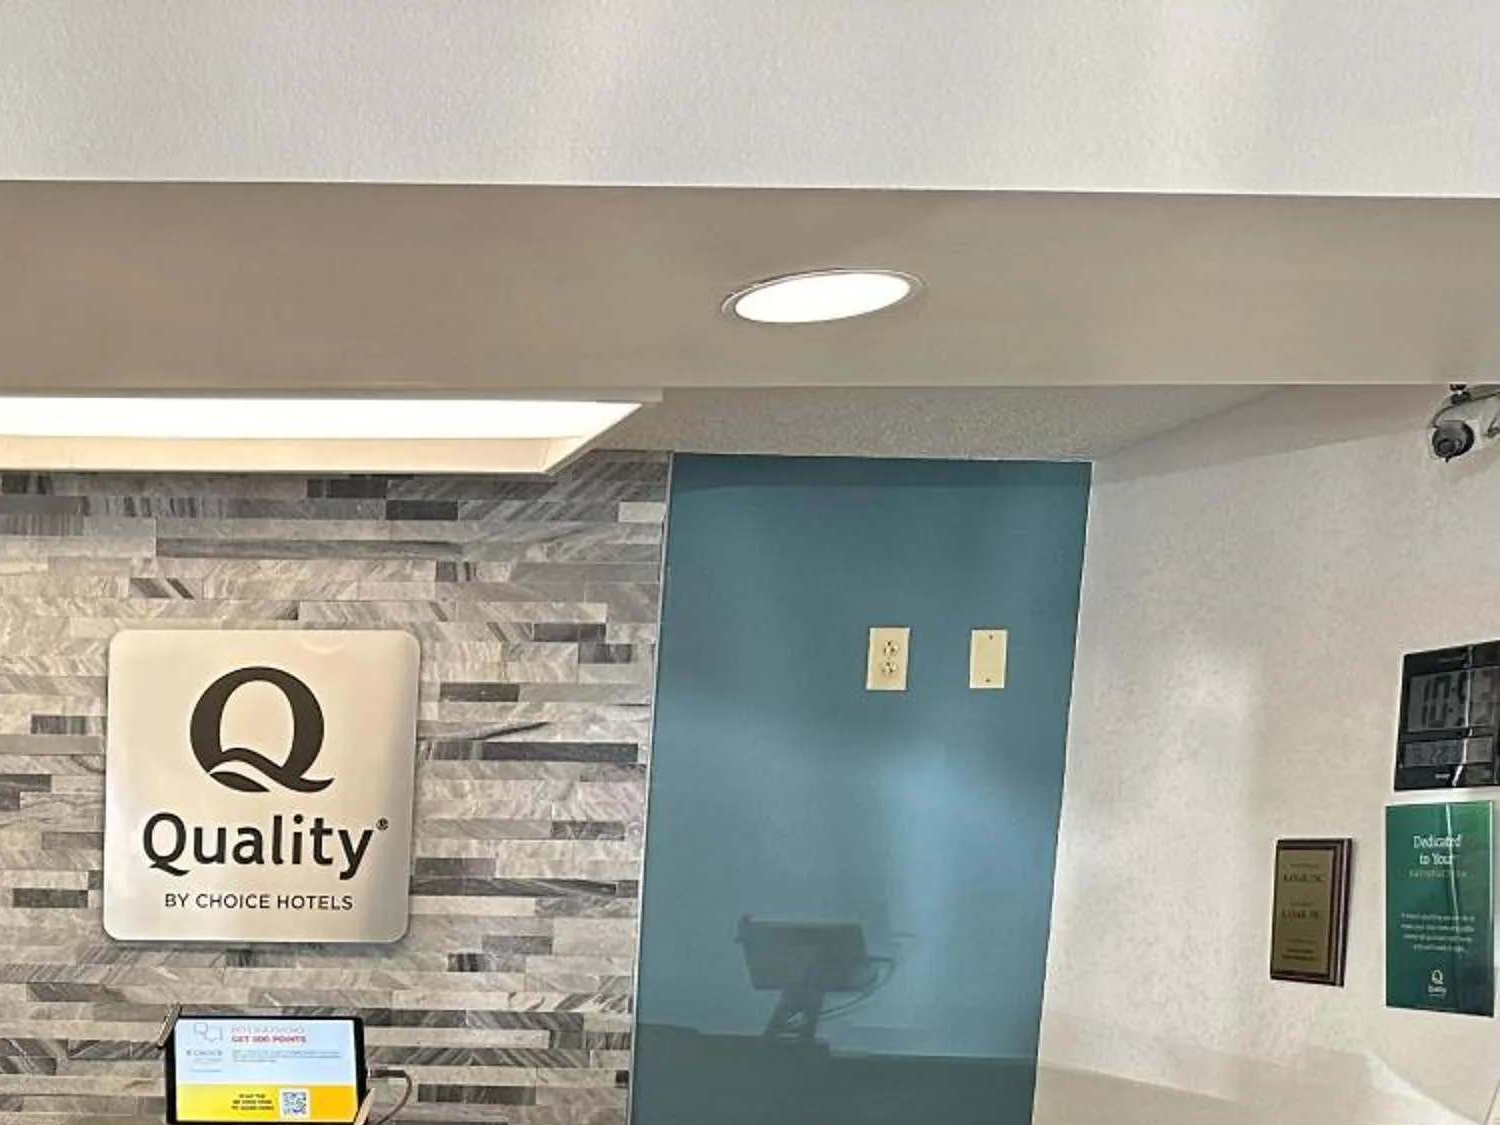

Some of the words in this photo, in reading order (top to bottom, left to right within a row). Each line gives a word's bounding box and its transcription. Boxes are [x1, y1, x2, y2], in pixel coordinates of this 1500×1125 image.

[190, 665, 334, 793] Q
[1413, 833, 1462, 849] Dedicated
[1419, 853, 1431, 865] to
[1431, 853, 1455, 865] Your
[165, 893, 189, 908] BY
[196, 893, 270, 909] CHOICE
[277, 894, 353, 911] HOTELS
